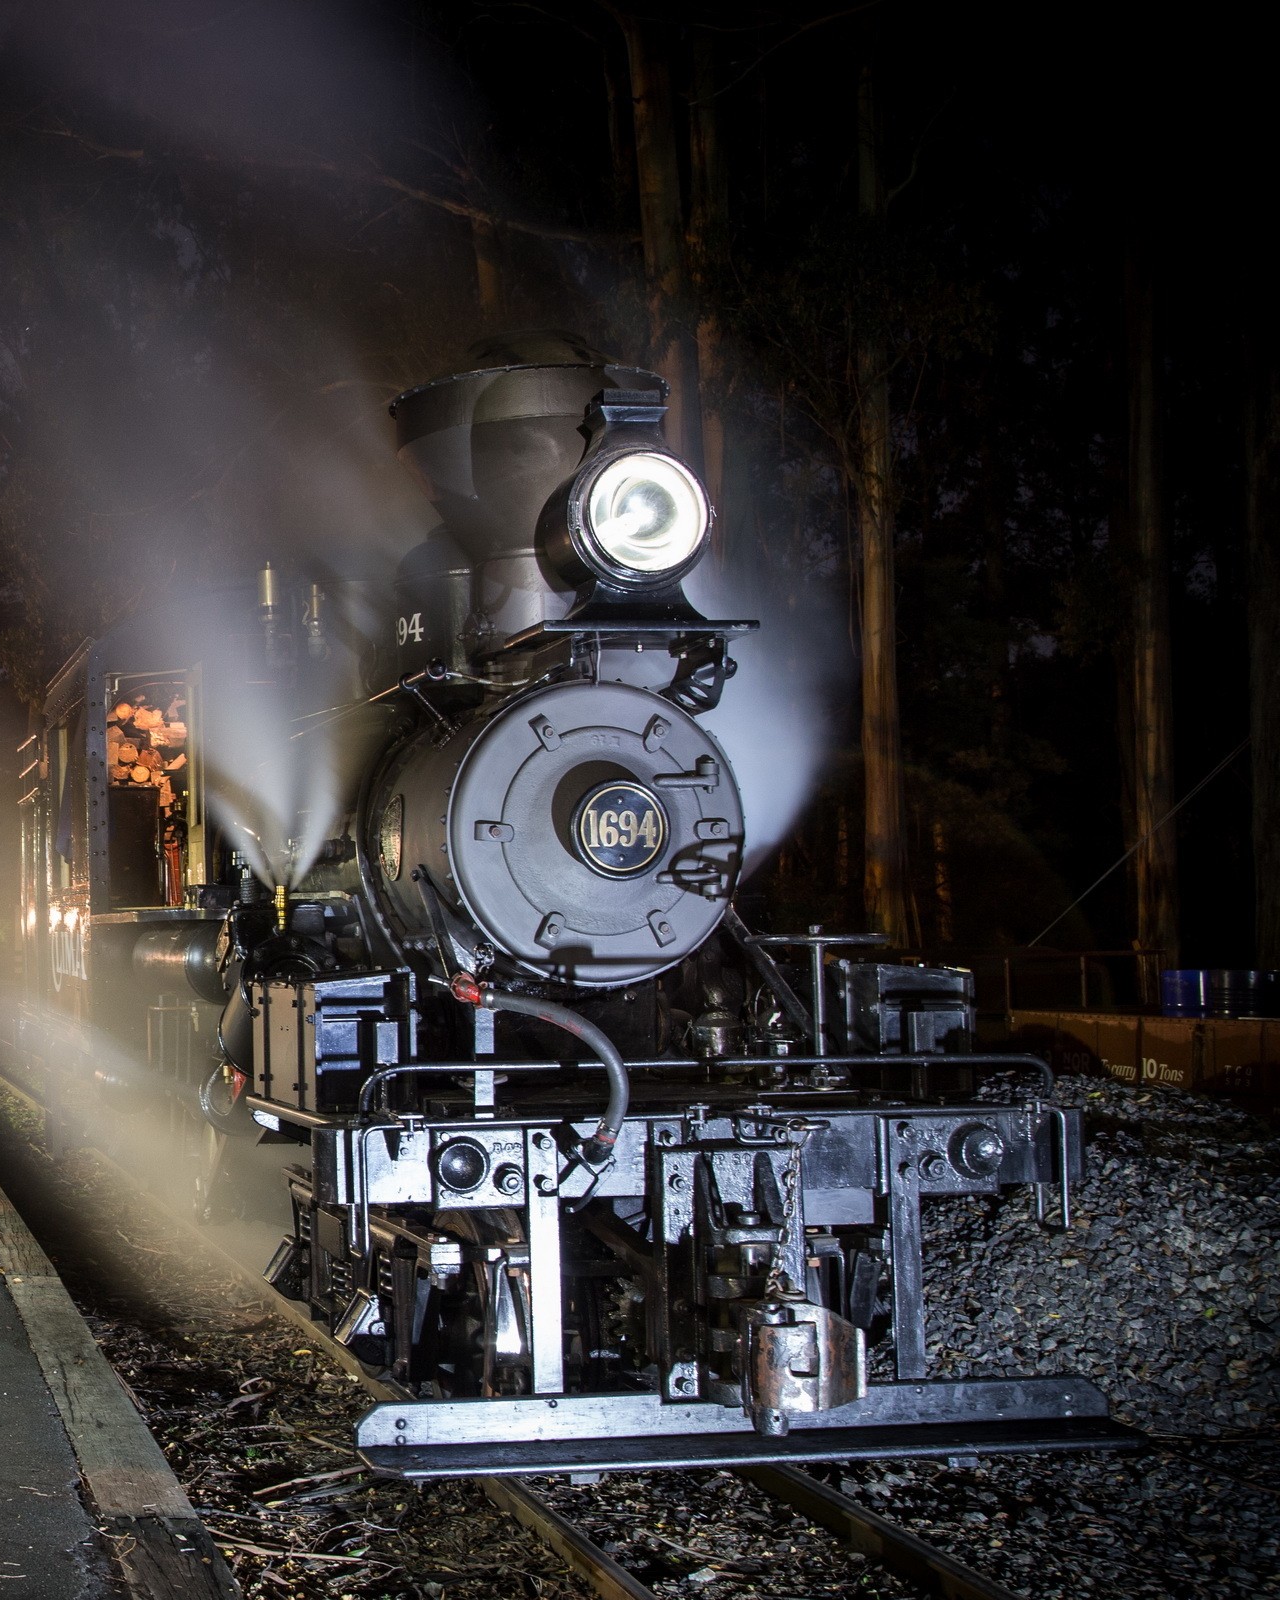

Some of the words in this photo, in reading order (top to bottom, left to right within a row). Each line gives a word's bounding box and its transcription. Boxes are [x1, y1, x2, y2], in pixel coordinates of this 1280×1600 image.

[588, 810, 656, 848] 1694
[1100, 1058, 1111, 1072] To
[1111, 1064, 1136, 1080] carry
[1141, 1057, 1158, 1079] 10
[1158, 1064, 1184, 1081] Tons
